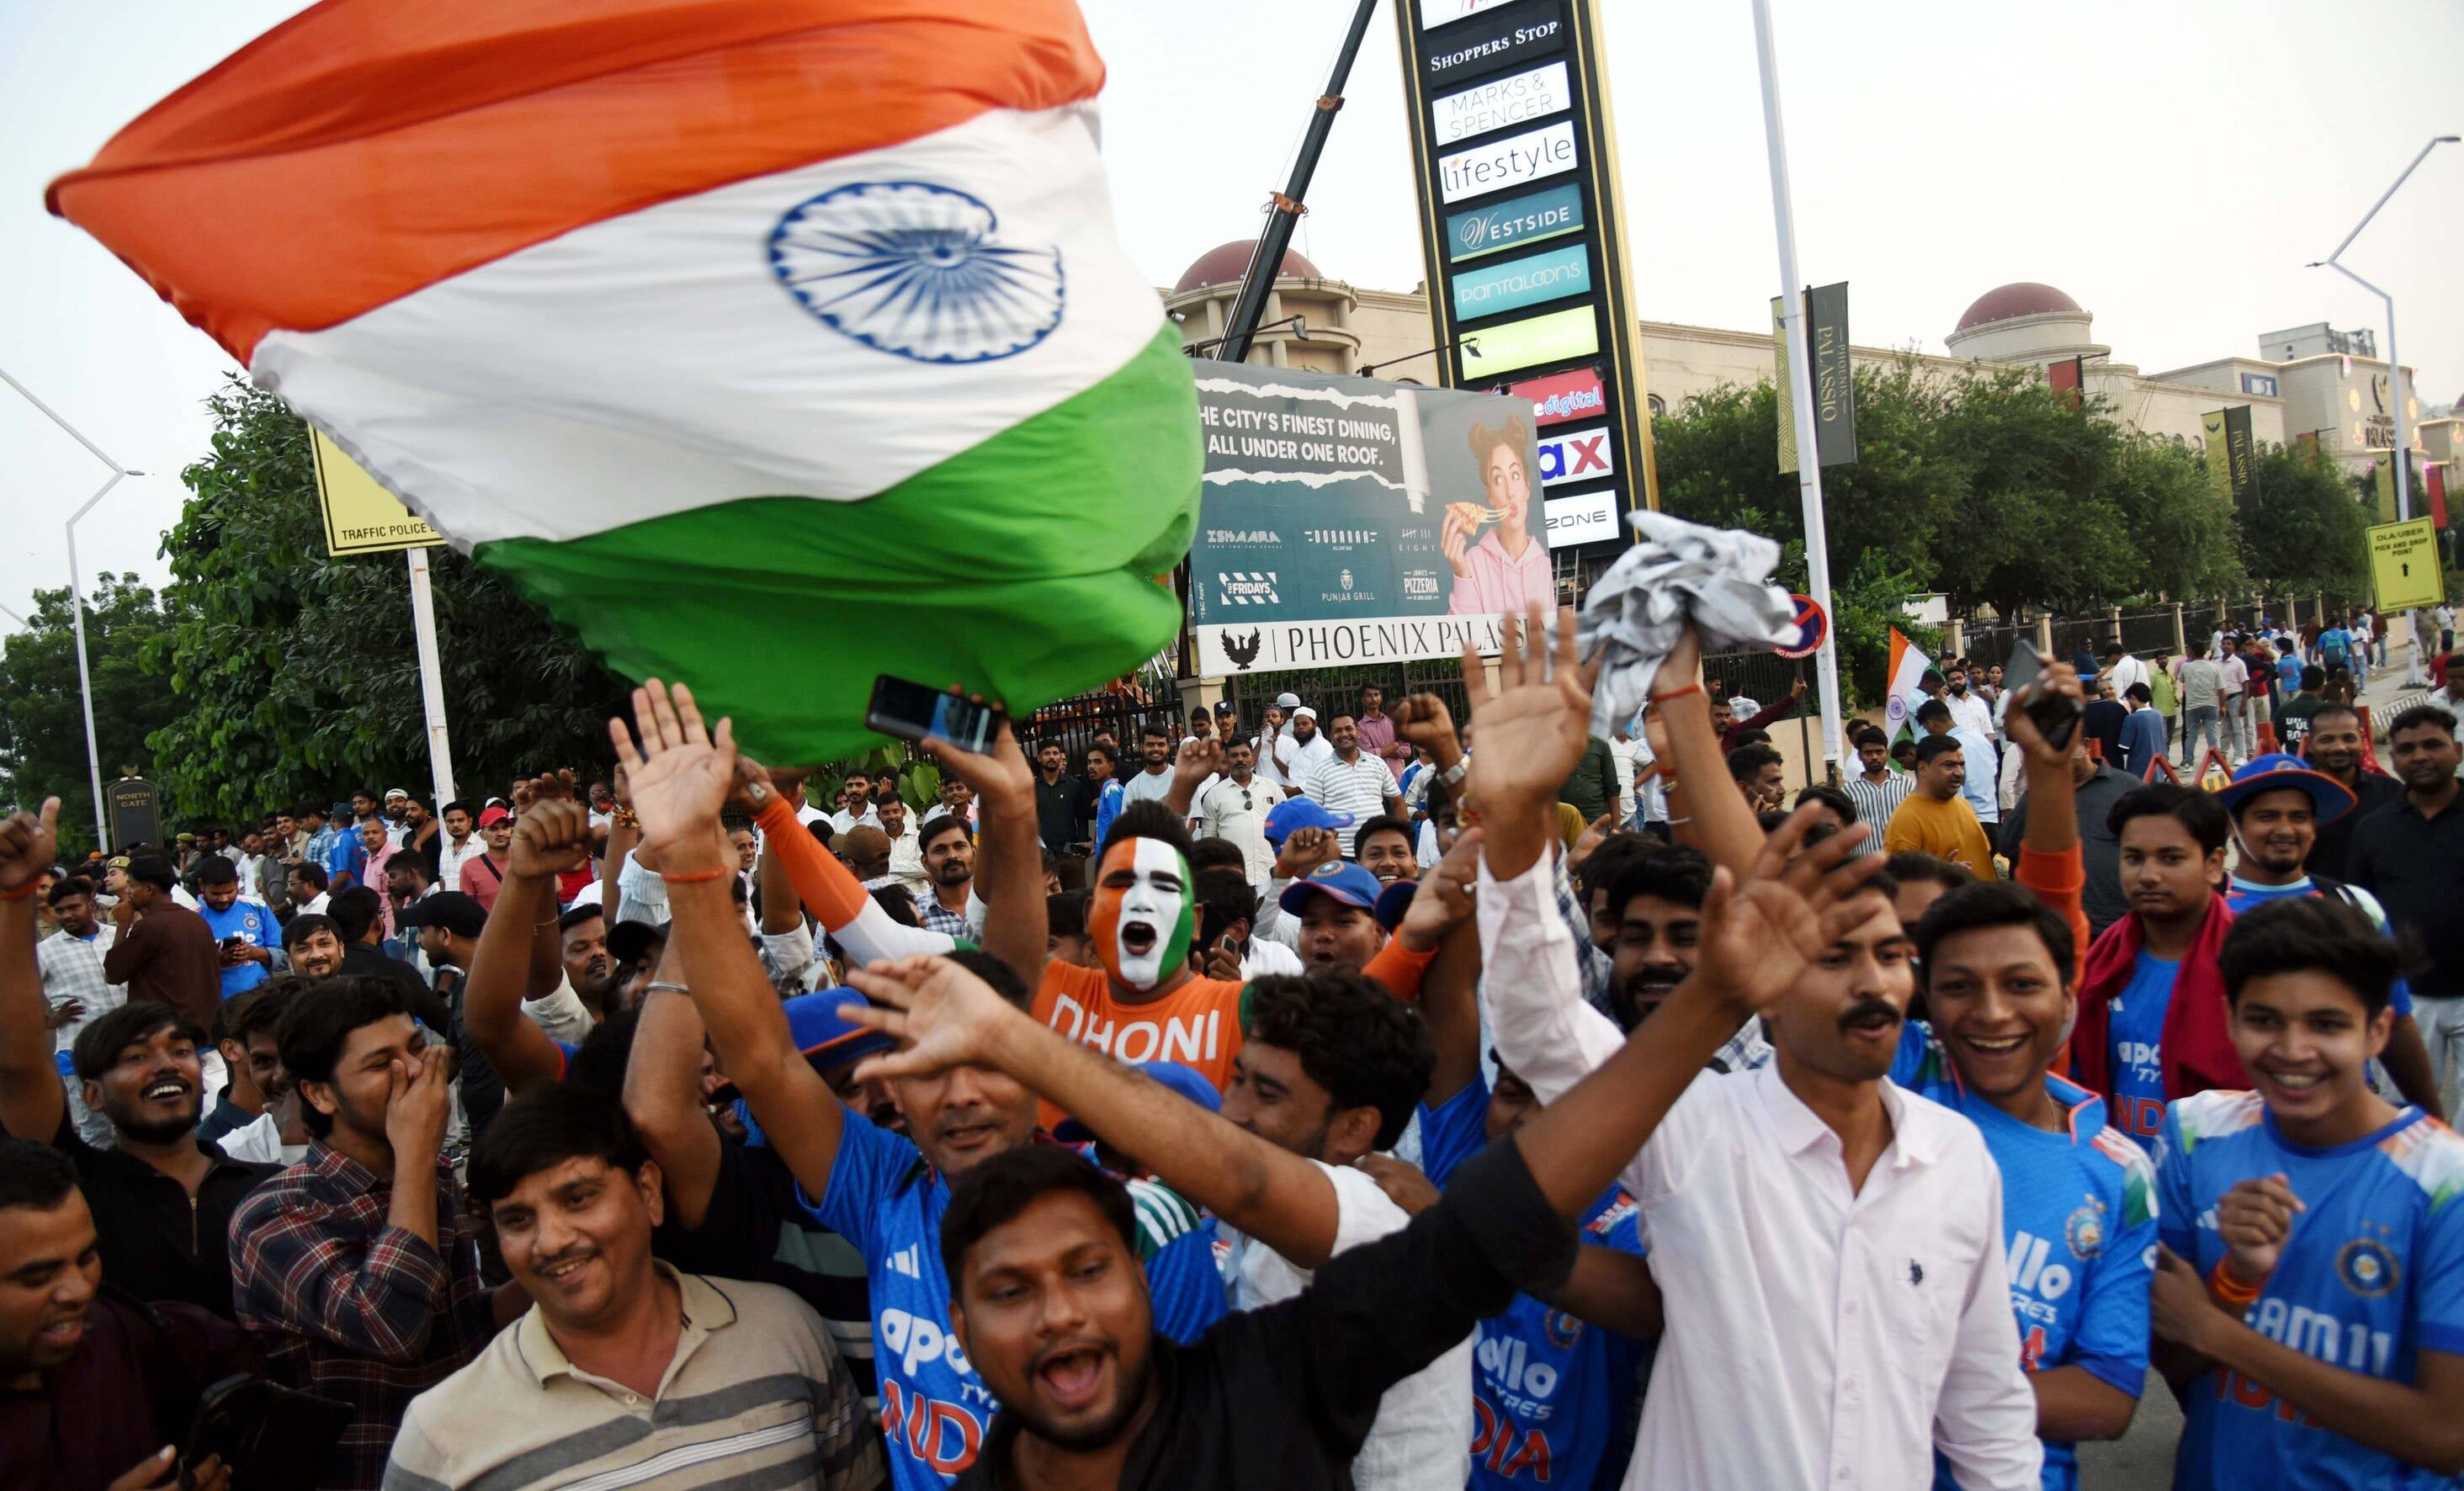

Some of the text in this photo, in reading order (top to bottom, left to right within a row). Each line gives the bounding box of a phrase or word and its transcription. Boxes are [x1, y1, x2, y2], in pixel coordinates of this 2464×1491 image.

[1431, 22, 1558, 72] SHOPPERS STOP
[1450, 93, 1554, 139] SPENCER
[1452, 72, 1546, 116] MARKS &
[1443, 136, 1571, 192] lifestyle
[1460, 206, 1570, 250] WESTSIDE
[1818, 326, 1837, 422] PALASSIO
[1838, 343, 1849, 397] PHOENIX
[1533, 386, 1602, 417] edigital
[1197, 406, 1395, 445] HE CITY'S FINEST DINING,
[1208, 434, 1383, 466] ALL UNDER ONE ROOF.
[1538, 434, 1610, 480] ax
[342, 527, 386, 540] TRAFFIC
[390, 523, 427, 536] POLICE
[1546, 510, 1607, 530] ZONE
[1232, 581, 1271, 595] FRIDAYS
[1321, 592, 1375, 602] PUNJAB GRILL
[1404, 577, 1439, 594] PIZZERIA
[1288, 618, 1546, 663] PHOENIX PALASSI
[1049, 993, 1219, 1066] DHONI
[2009, 1230, 2072, 1300] llo
[880, 1308, 972, 1377] apo
[1469, 1393, 1551, 1483] DIA
